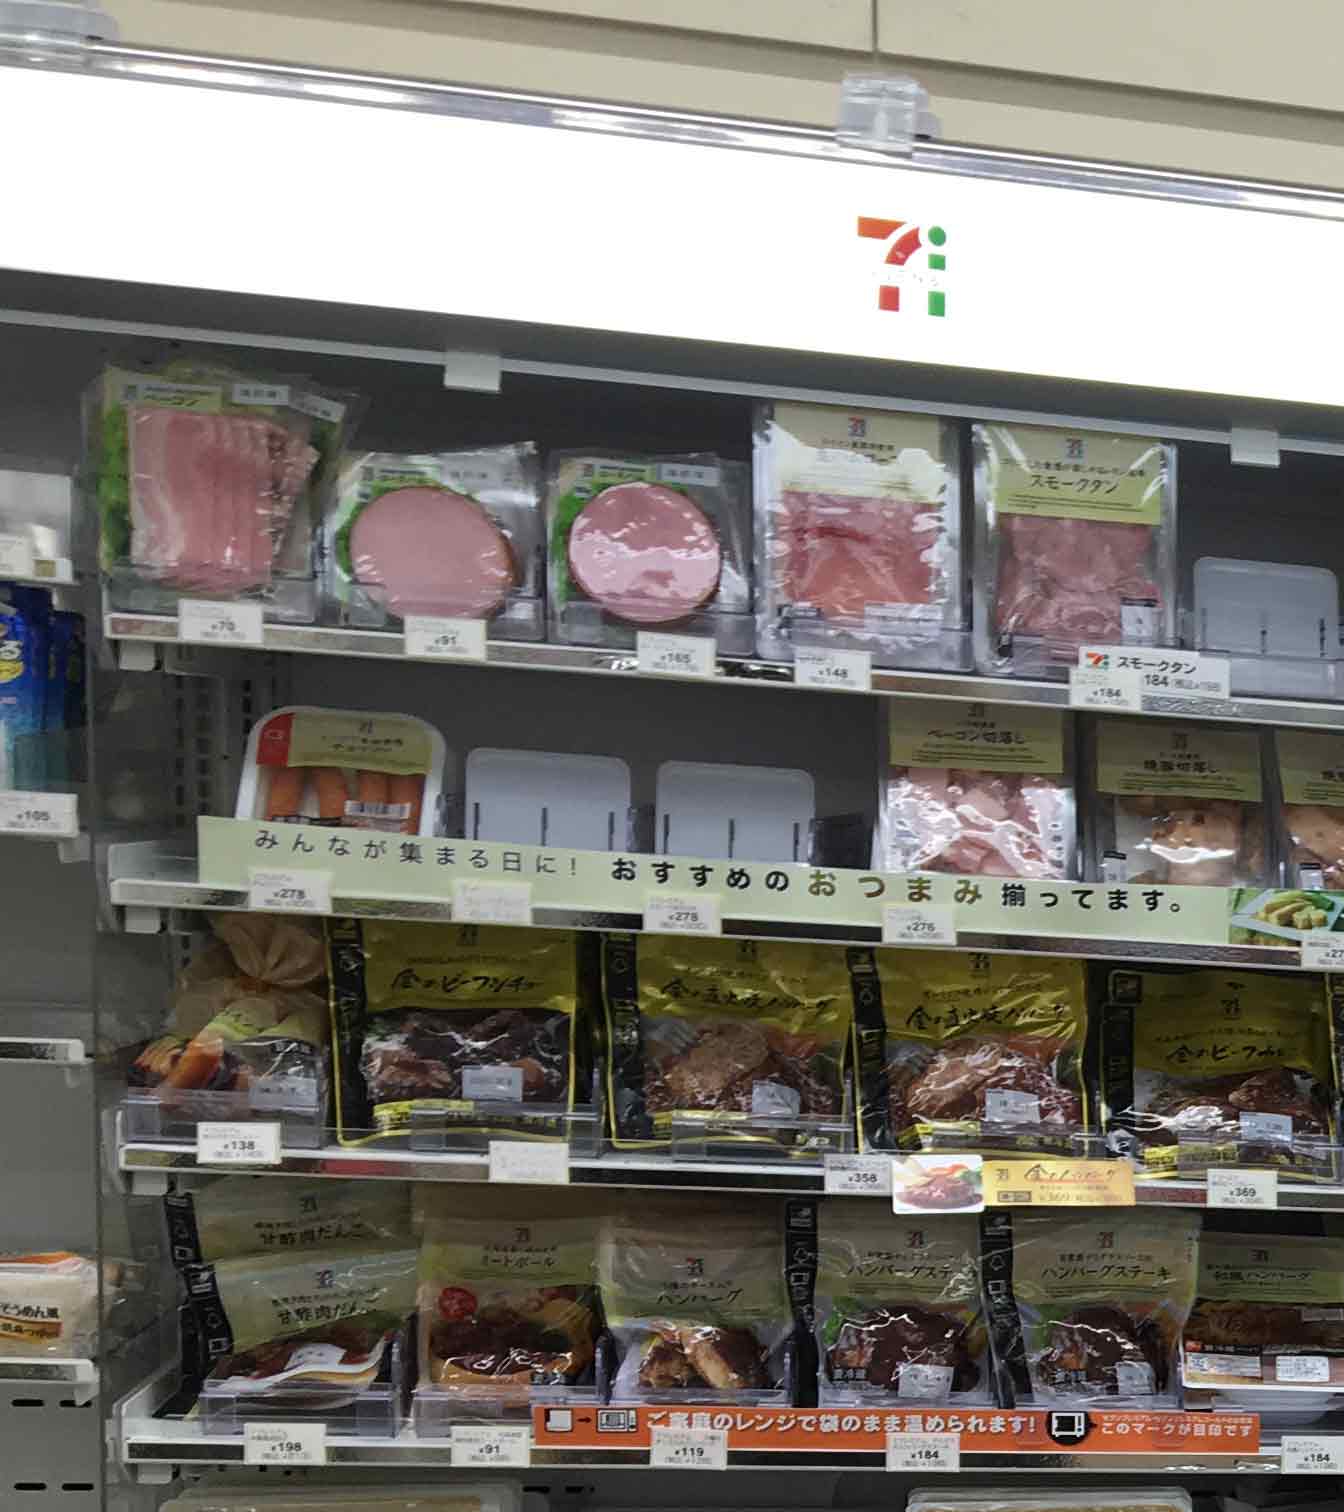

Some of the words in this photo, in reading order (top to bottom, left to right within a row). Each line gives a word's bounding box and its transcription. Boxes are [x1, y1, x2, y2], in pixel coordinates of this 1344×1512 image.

[1117, 657, 1197, 675] スモークタン
[1041, 1259, 1174, 1283] ハンバーグステーキ
[1102, 1421, 1253, 1436] このマークが目印です
[675, 1447, 704, 1457] ¥119
[911, 1449, 940, 1460] ¥184
